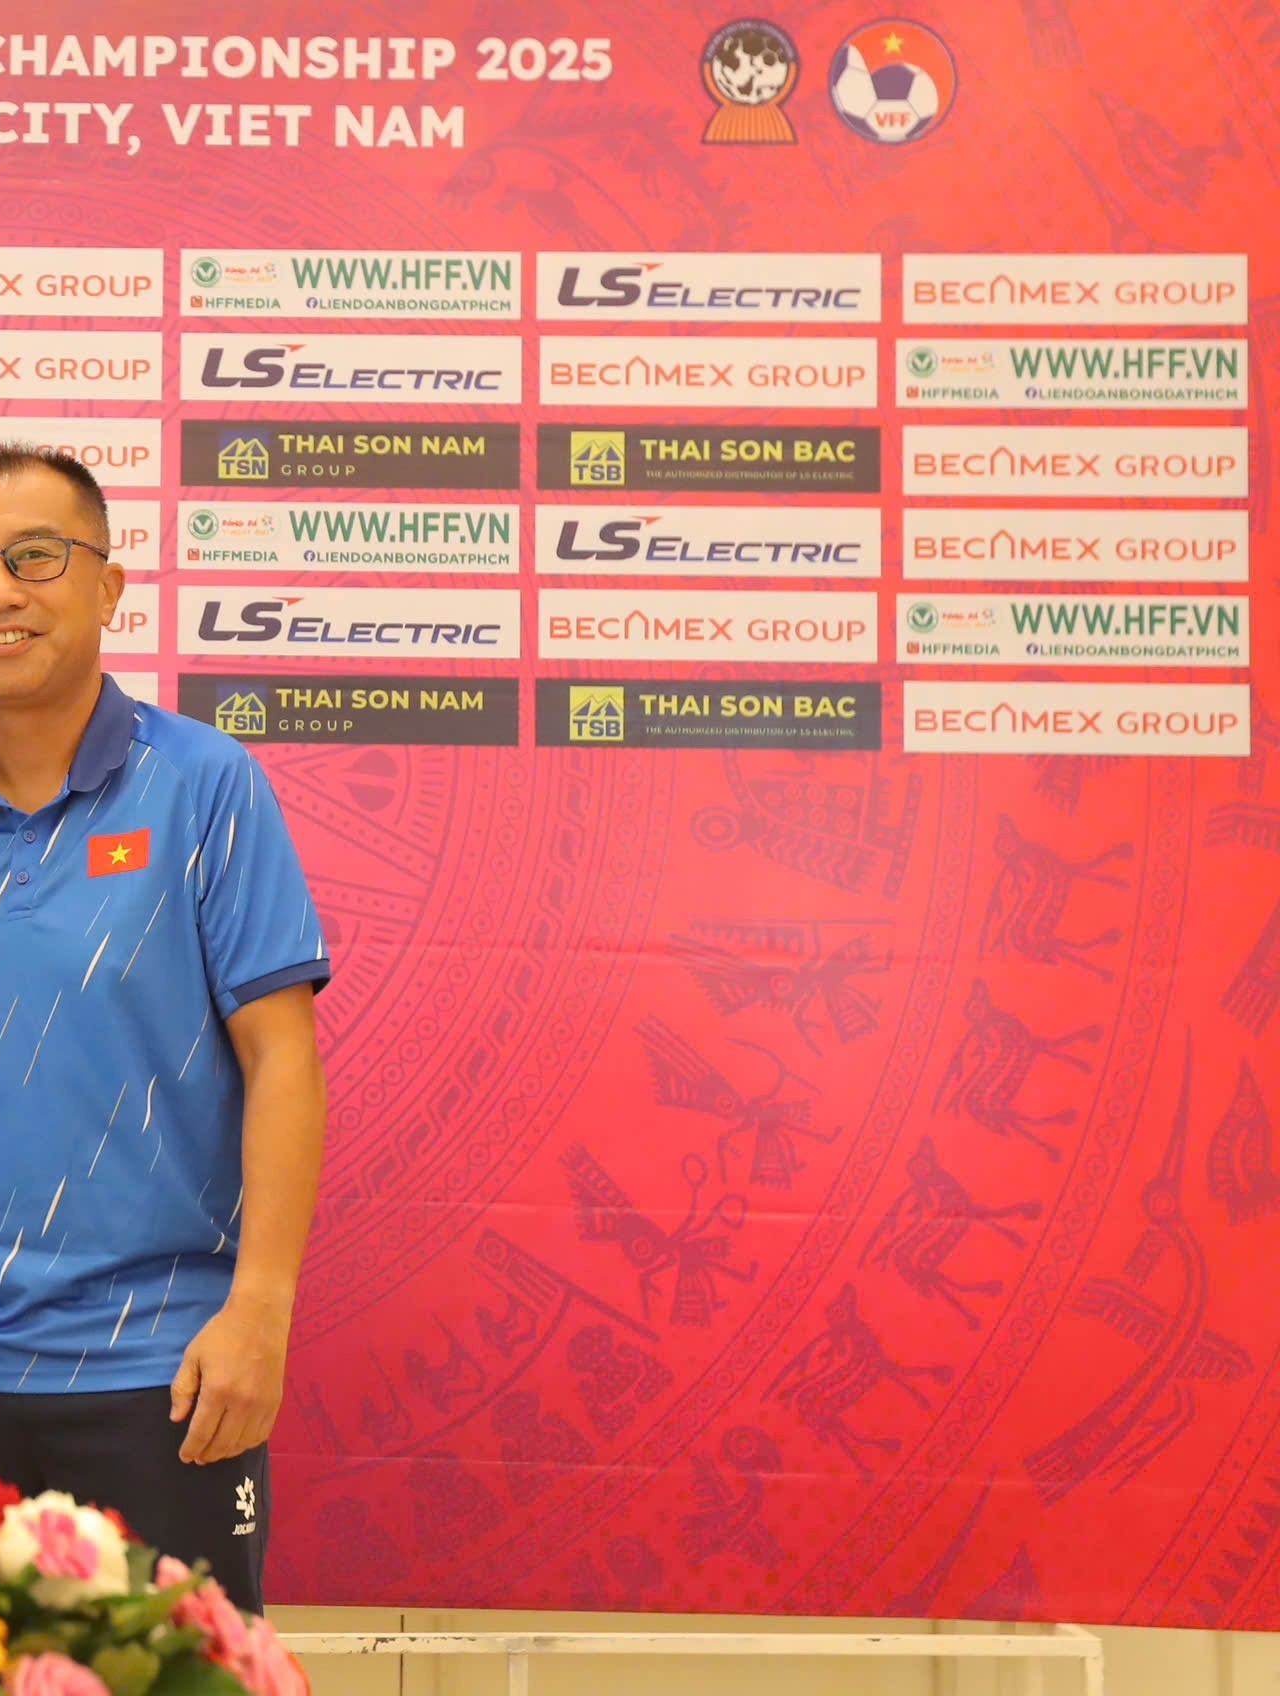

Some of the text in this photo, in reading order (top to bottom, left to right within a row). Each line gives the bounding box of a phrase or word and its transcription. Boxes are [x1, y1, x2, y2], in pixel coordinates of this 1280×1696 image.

[477, 38, 612, 80] 2025
[162, 104, 311, 145] VIET
[336, 106, 464, 147] NAM
[874, 111, 912, 128] VFF
[292, 258, 510, 290] WWW.HFF.VN
[36, 275, 152, 297] GROUP
[557, 267, 860, 308] LS ELECTRIC
[914, 275, 1235, 304] BECAMEX GROUP
[205, 298, 281, 309] HFFMEDIA
[320, 299, 510, 310] LIENDOANBONGDATPHCM
[35, 358, 150, 380] GROUP
[201, 348, 502, 390] LS ELECTRIC
[551, 356, 865, 387] BECAMEX GROUP
[1010, 349, 1237, 378] WWW.HFF.VN
[921, 387, 999, 400] HFFMEDIA
[1039, 387, 1238, 400] LIENDOANBONGDATPHCM
[278, 435, 484, 455] THAI SON NAM
[640, 440, 854, 462] THAI SON BAC
[222, 459, 266, 476] TSN
[281, 465, 355, 475] GROUP
[574, 464, 621, 480] TSB
[914, 447, 1236, 477] BECAMEX GROUP
[289, 511, 509, 544] WWW.HFF.VN
[556, 521, 861, 562] LS ELECTRIC
[914, 530, 1236, 561] BECAMEX GROUP
[203, 551, 278, 561] HFFMEDIA
[317, 552, 509, 564] LIENDOANBONGDATPHCM
[198, 602, 500, 644] LS ELECTRIC
[550, 610, 865, 642] BECAMEX GROUP
[1011, 604, 1238, 635] WWW.HFF.VN
[923, 644, 999, 654] HFFMEDIA
[1041, 645, 1239, 656] LIENDOANBONGDATPHCM
[276, 689, 483, 710] THAI SON NAM
[640, 695, 855, 717] THAI SON BAC
[218, 714, 263, 731] TSN
[279, 720, 352, 731] GROUP
[573, 720, 620, 736] TSB
[915, 703, 1238, 735] BECAMEX GROUP
